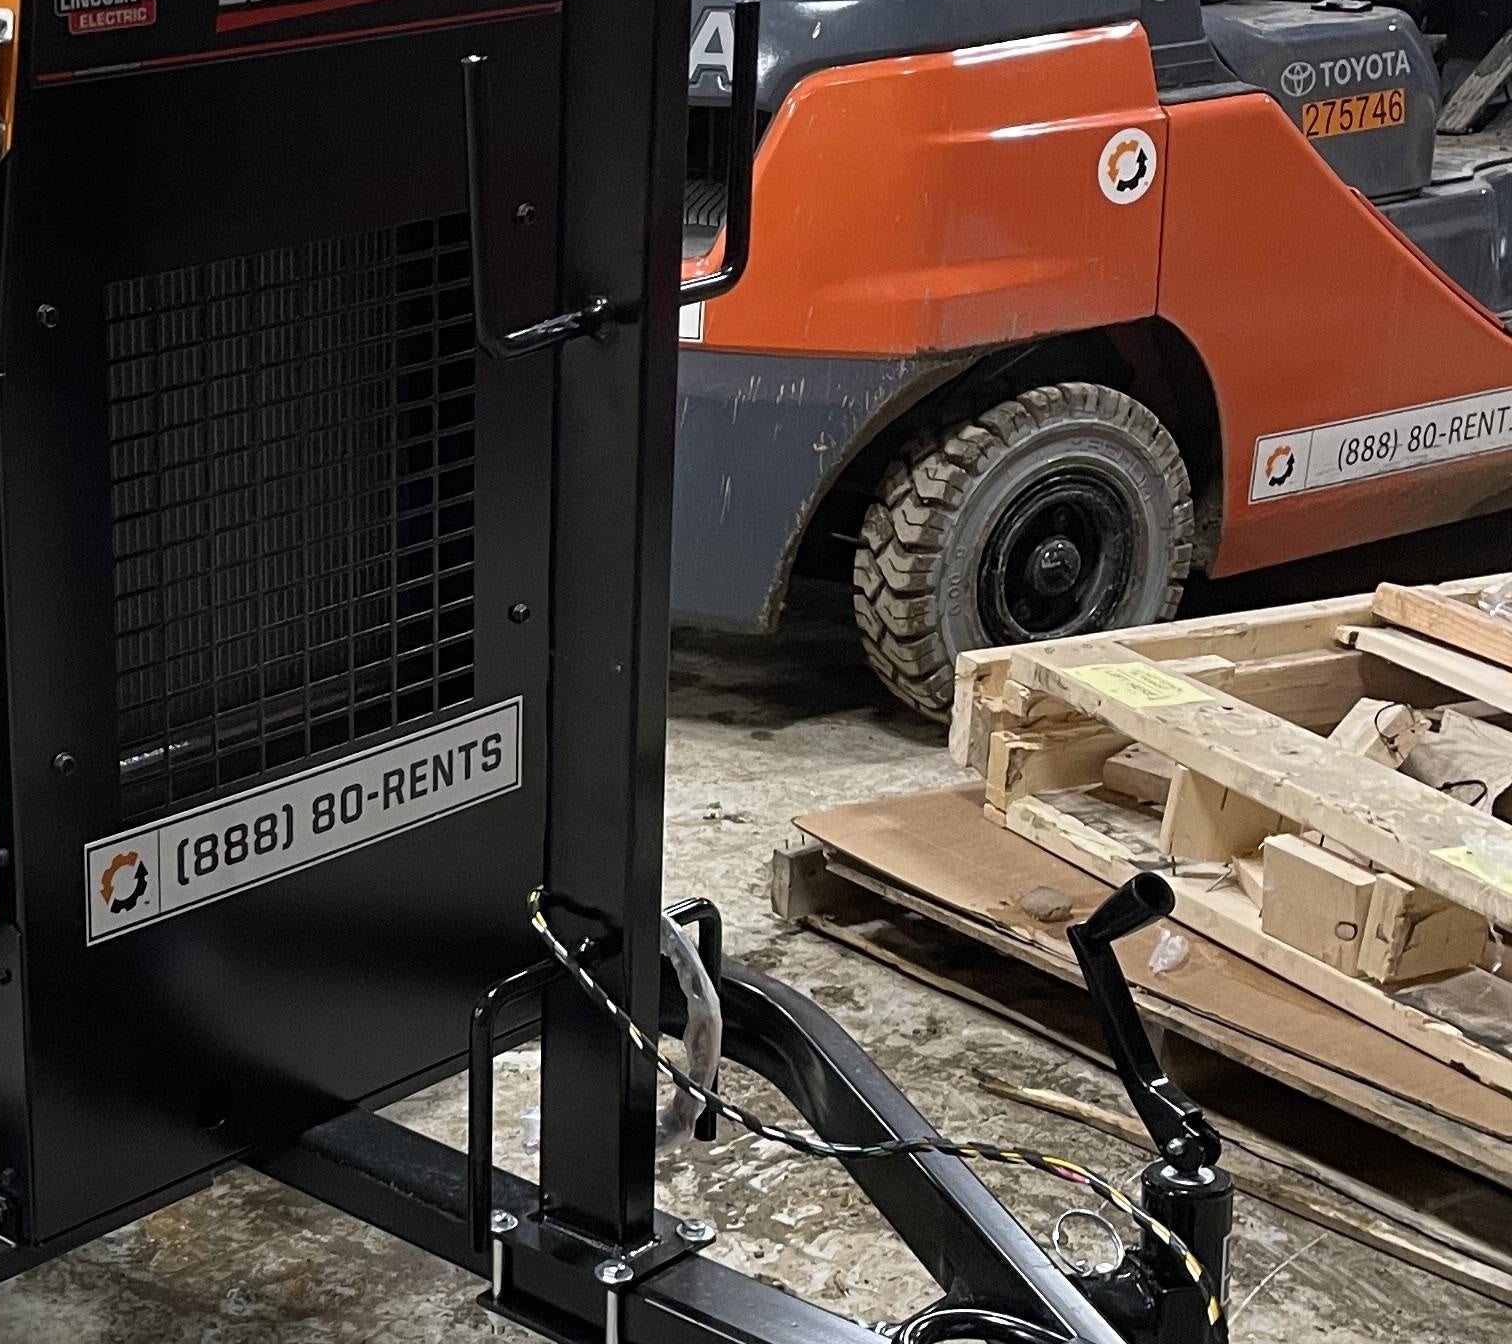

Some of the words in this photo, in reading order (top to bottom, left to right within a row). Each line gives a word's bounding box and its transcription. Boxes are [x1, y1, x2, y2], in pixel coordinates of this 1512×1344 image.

[79, 7, 147, 29] ELECTRIC
[1319, 49, 1411, 87] TOYOTA
[1306, 90, 1402, 137] 275746
[1338, 428, 1399, 472] (888)
[1407, 406, 1512, 453] 80-RENT
[177, 803, 294, 886] (888)
[312, 732, 502, 835] 80-RENTS
